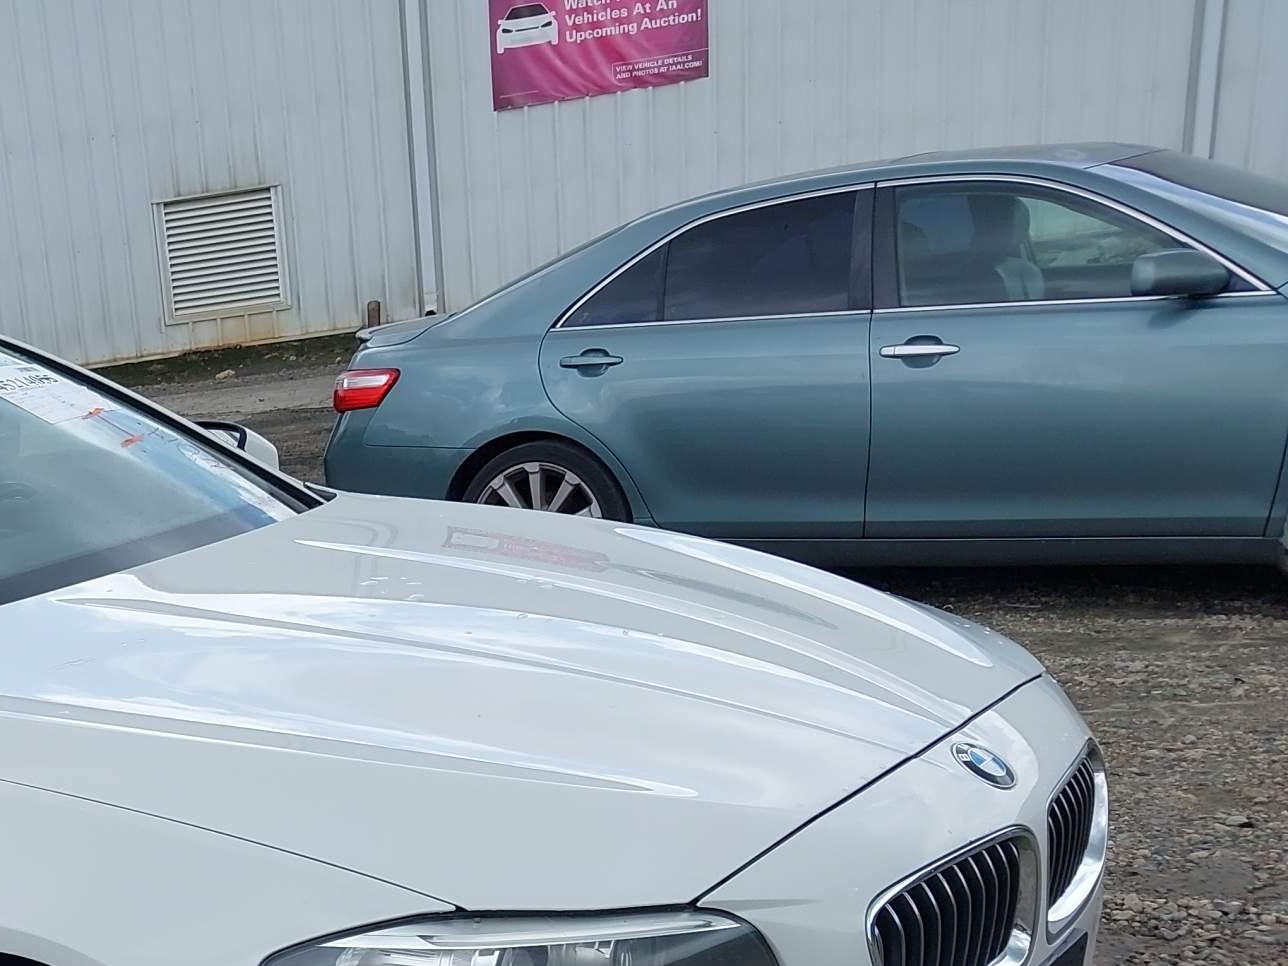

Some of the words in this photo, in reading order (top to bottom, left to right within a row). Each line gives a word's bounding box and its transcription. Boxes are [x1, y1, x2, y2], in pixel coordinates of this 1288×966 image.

[565, 8, 628, 26] Vehicles
[633, 3, 651, 15] At
[656, 0, 677, 11] An
[565, 23, 638, 43] Upcoming
[640, 8, 702, 30] Auction!
[615, 63, 632, 73] VIEW
[634, 59, 663, 70] VEHICLE
[664, 55, 693, 65] DETAILS
[615, 71, 631, 79] AND
[632, 67, 658, 77] PHOTOS
[659, 65, 668, 73] AT
